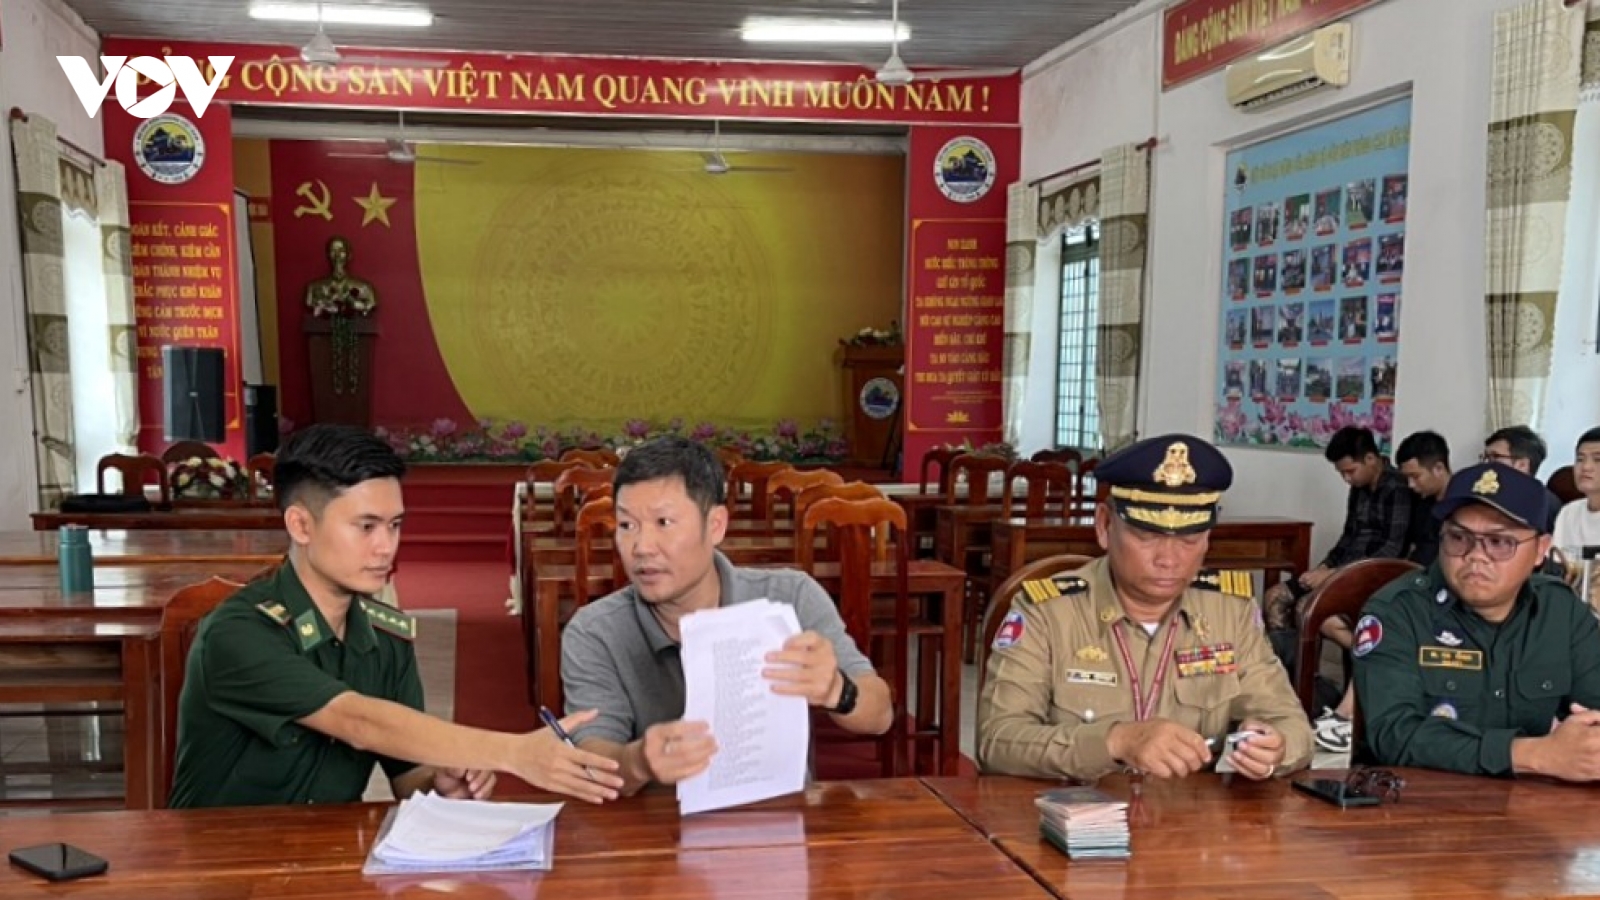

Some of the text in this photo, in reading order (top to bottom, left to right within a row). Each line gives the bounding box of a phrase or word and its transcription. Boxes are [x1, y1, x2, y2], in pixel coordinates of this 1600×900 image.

[241, 54, 337, 97] CỘNG
[422, 61, 501, 103] VIỆT
[511, 73, 585, 102] NAM
[593, 75, 706, 108] QUANG
[718, 79, 794, 107] VINH
[803, 74, 895, 110] MUÔN
[903, 78, 973, 112] NĂM
[981, 85, 990, 112] !
